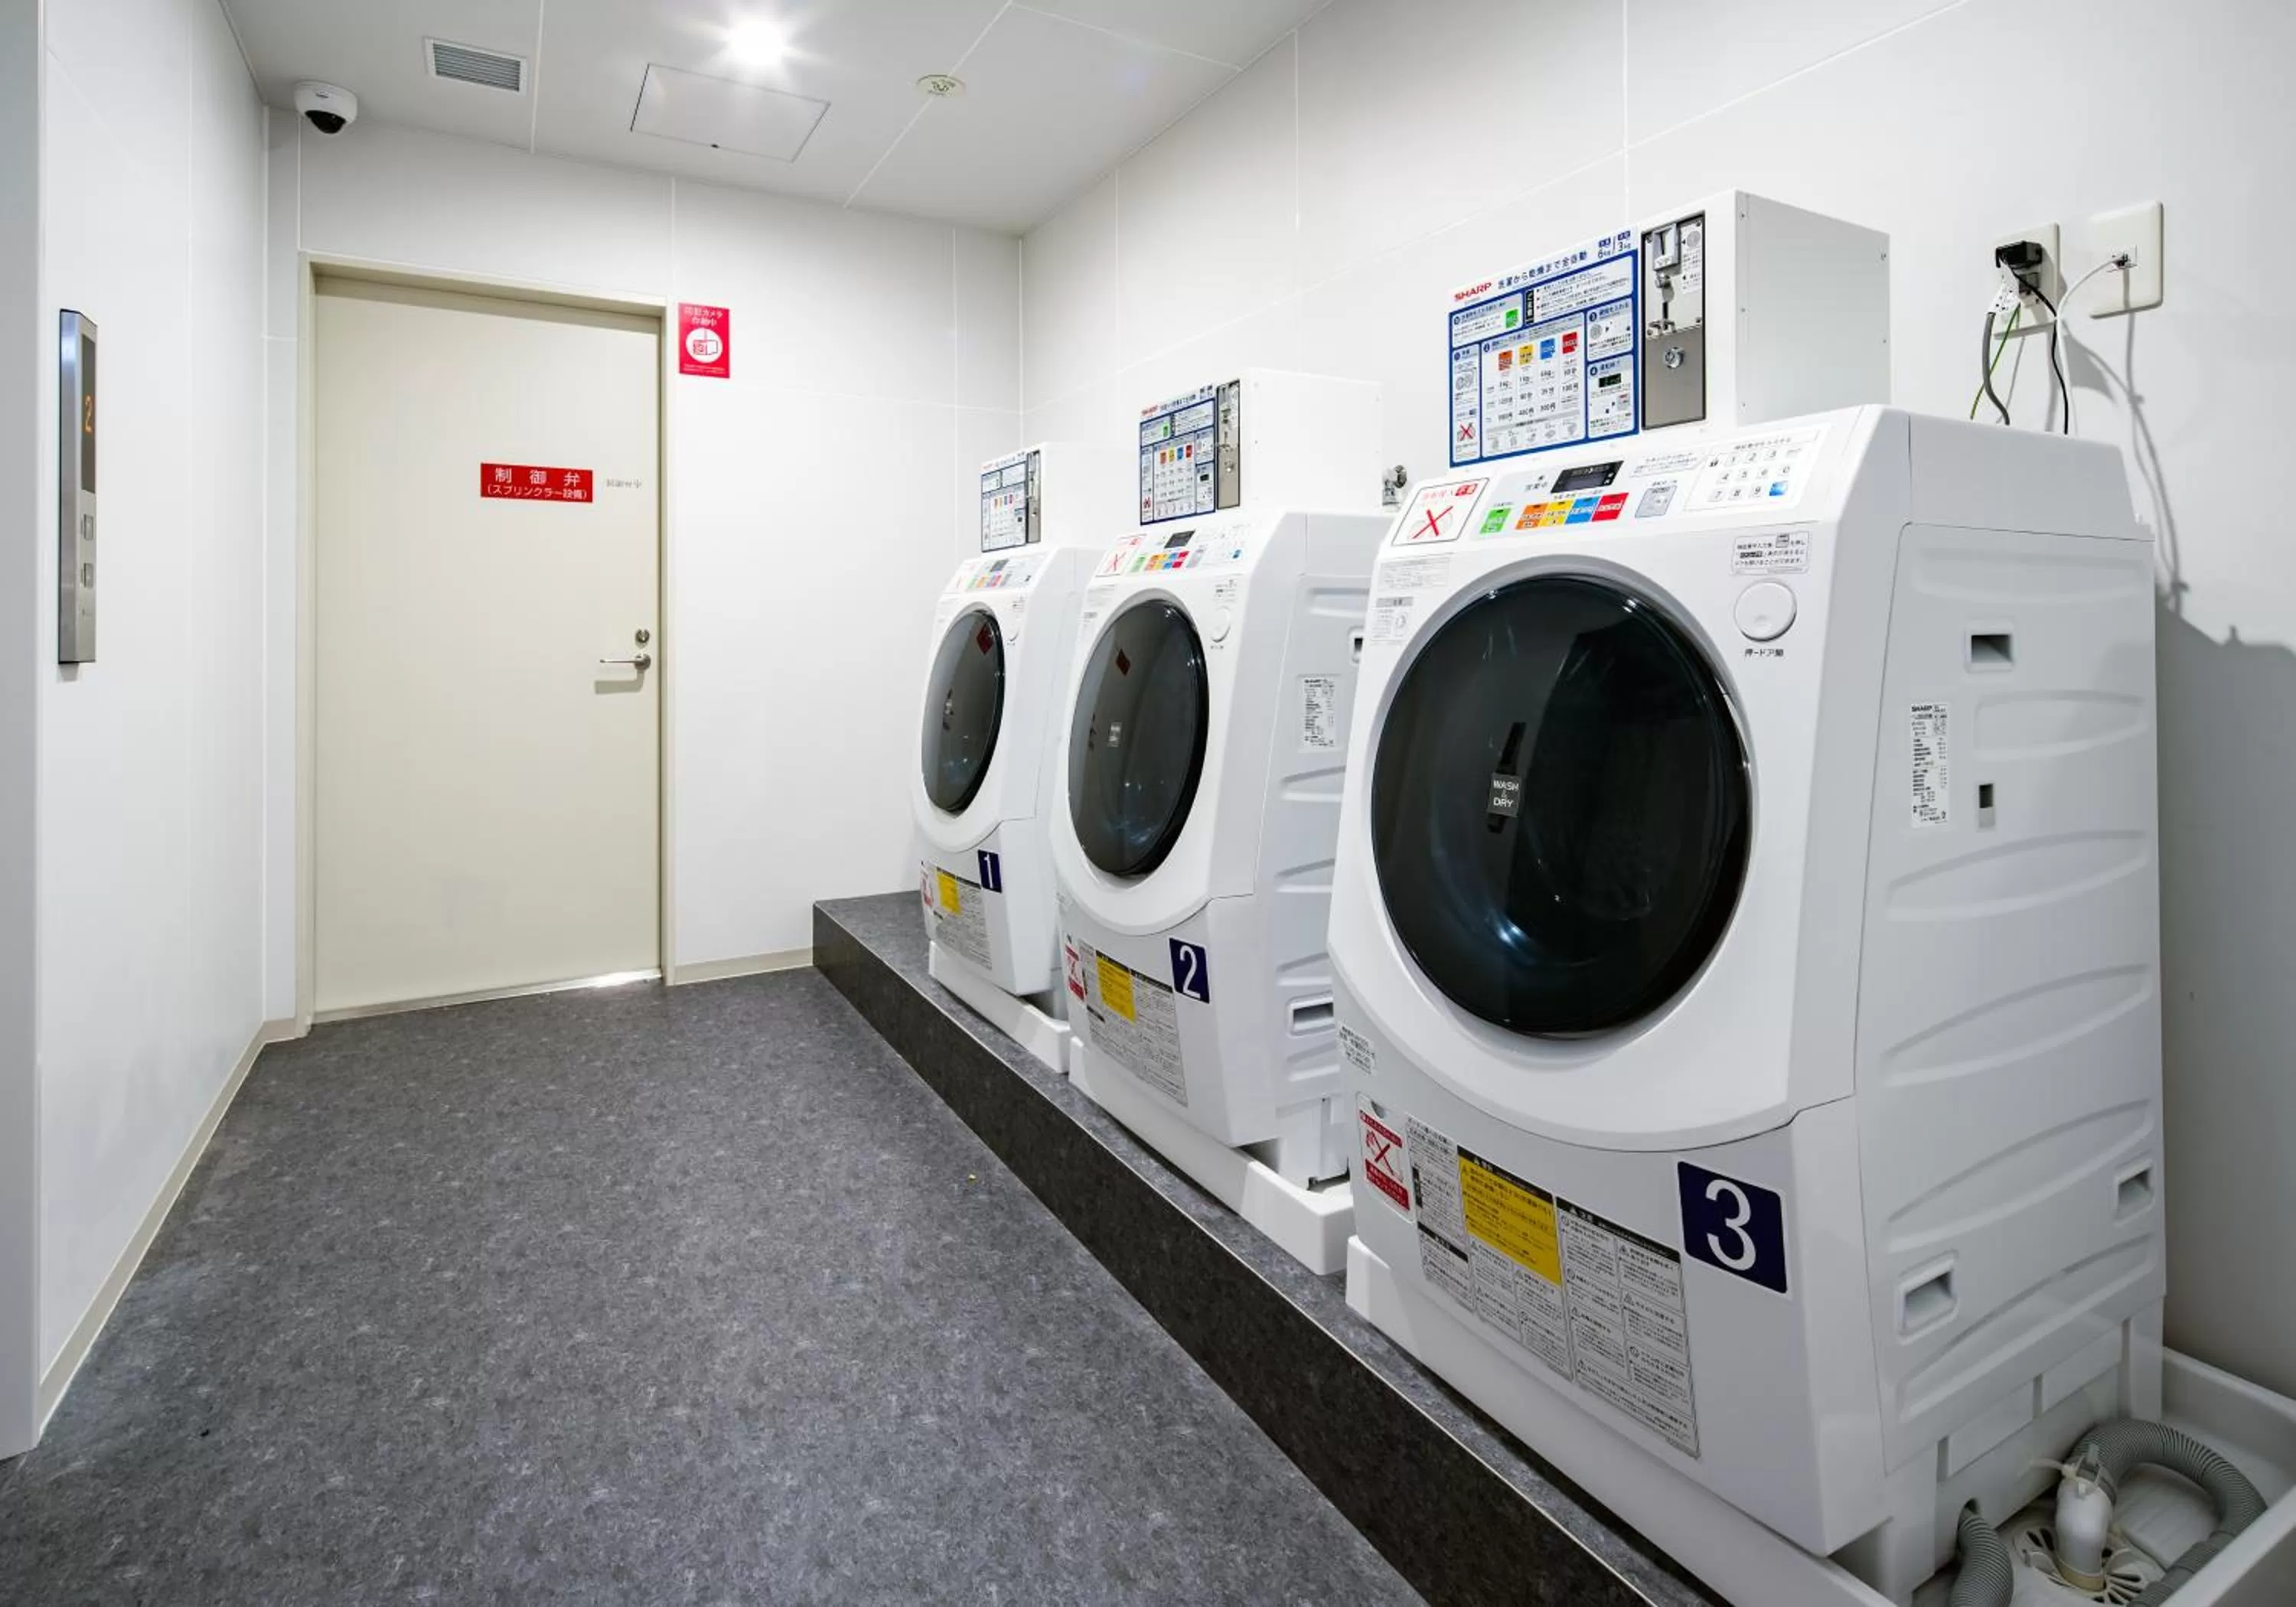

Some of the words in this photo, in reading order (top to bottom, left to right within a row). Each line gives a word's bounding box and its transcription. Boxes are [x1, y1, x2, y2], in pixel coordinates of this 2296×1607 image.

[1454, 282, 1492, 302] SHARP
[84, 393, 93, 434] 2
[1493, 780, 1519, 791] WASH
[1493, 797, 1514, 807] DRY
[983, 853, 993, 888] 1
[1179, 944, 1201, 999] 2
[1705, 1179, 1756, 1271] 3
